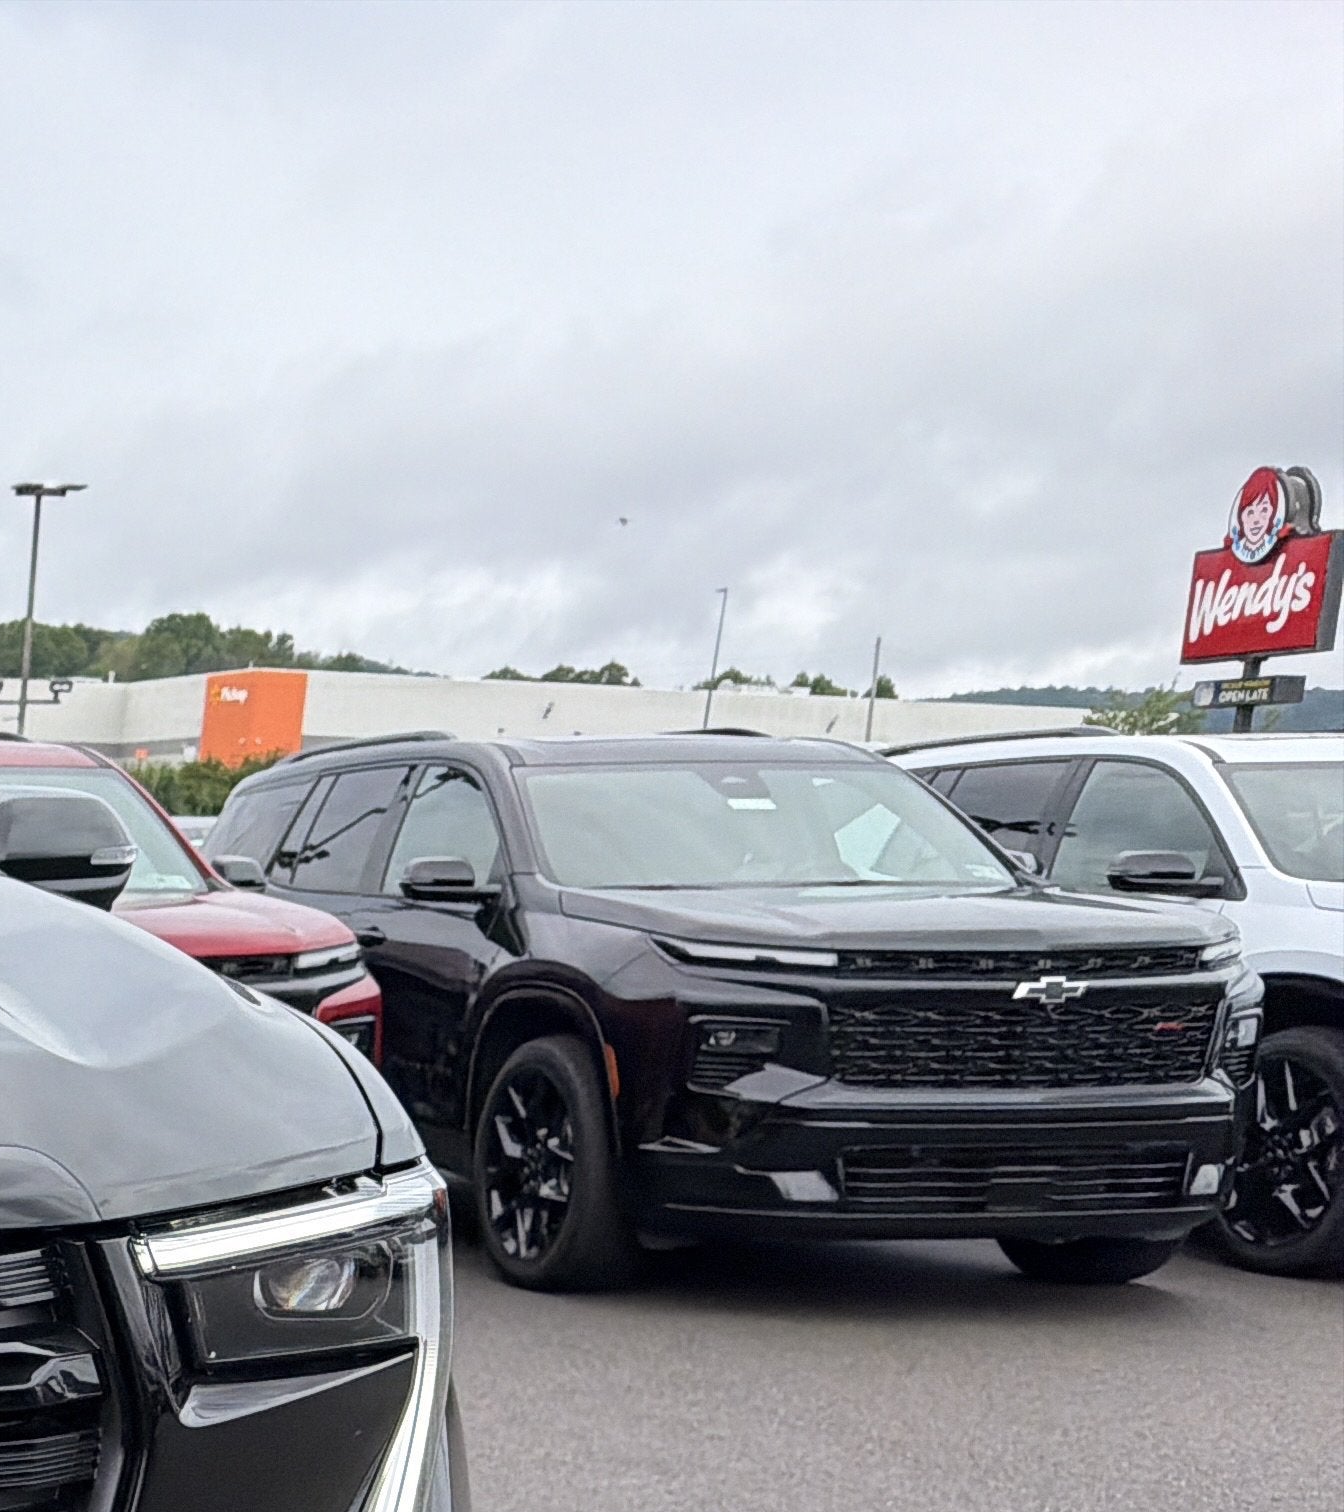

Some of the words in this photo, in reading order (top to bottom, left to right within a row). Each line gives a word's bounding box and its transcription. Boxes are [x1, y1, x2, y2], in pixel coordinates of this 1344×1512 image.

[1188, 552, 1316, 644] Wendy's
[1218, 689, 1245, 703] OPEN
[1245, 687, 1270, 702] LATE
